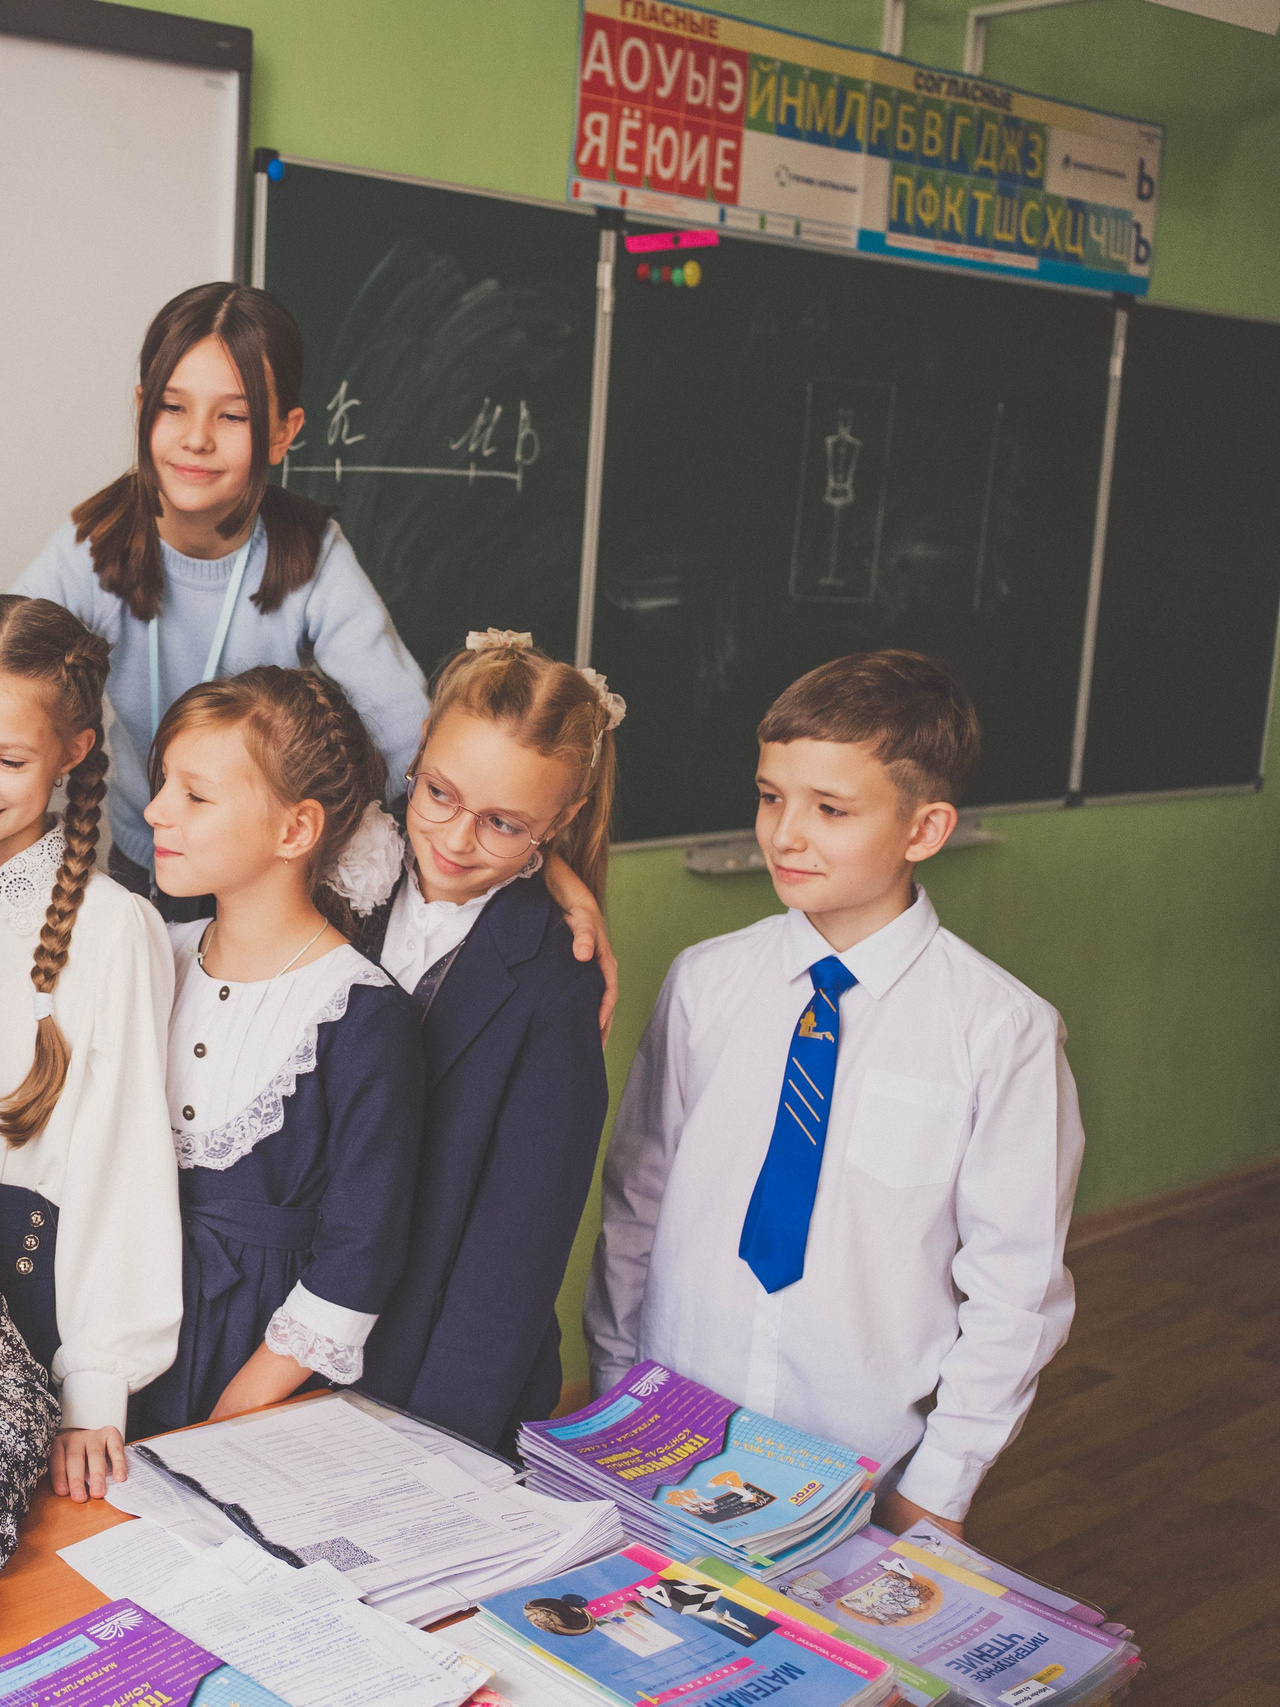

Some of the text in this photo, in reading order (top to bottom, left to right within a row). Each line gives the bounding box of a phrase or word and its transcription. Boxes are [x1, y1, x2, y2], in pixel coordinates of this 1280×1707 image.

[913, 71, 1012, 112] СОГЛАСНЫЕ
[614, 1433, 710, 1482] ТЕМАТИЧЕСКИЙ
[642, 1426, 693, 1458] КОНТРОЛЬ
[789, 1481, 818, 1503] ФГОС
[876, 1557, 912, 1578] 4
[633, 1584, 671, 1607] 4
[943, 1632, 1026, 1675] ЧТЕНИЕ
[968, 1631, 1050, 1683] ЛИТЕРАТУРНОЕ
[51, 1660, 119, 1698] МАТЕМАТИКА
